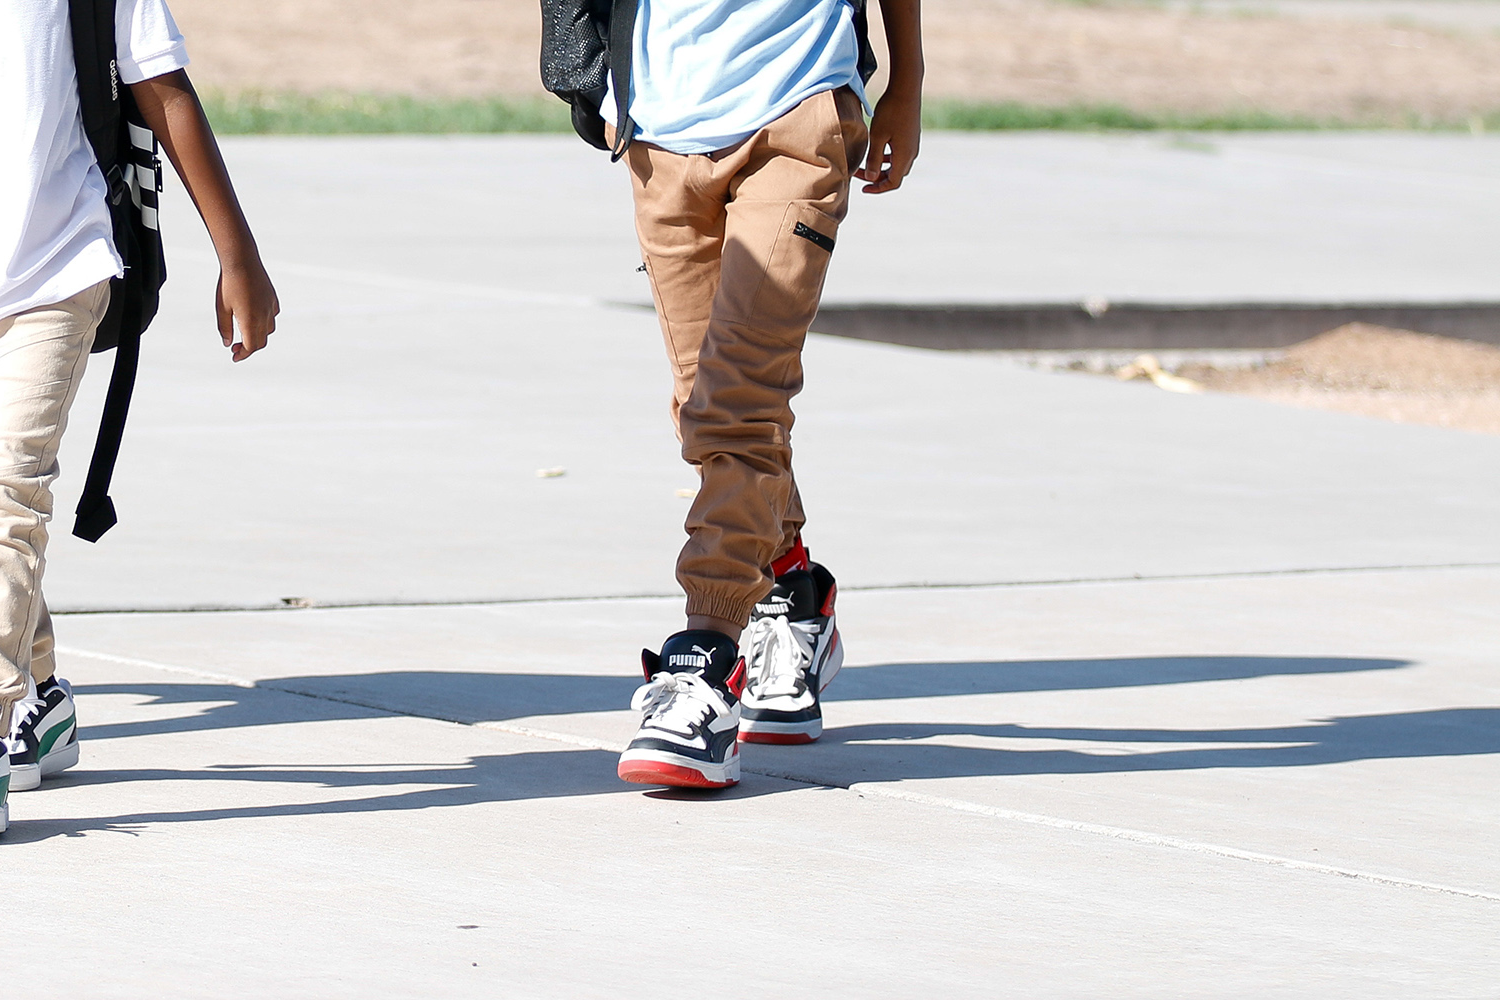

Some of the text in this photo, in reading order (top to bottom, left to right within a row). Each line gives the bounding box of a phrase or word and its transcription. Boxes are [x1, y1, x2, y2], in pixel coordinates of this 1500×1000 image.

[109, 59, 119, 101] adidas
[754, 602, 790, 615] PUMA
[668, 654, 706, 668] PUMA
